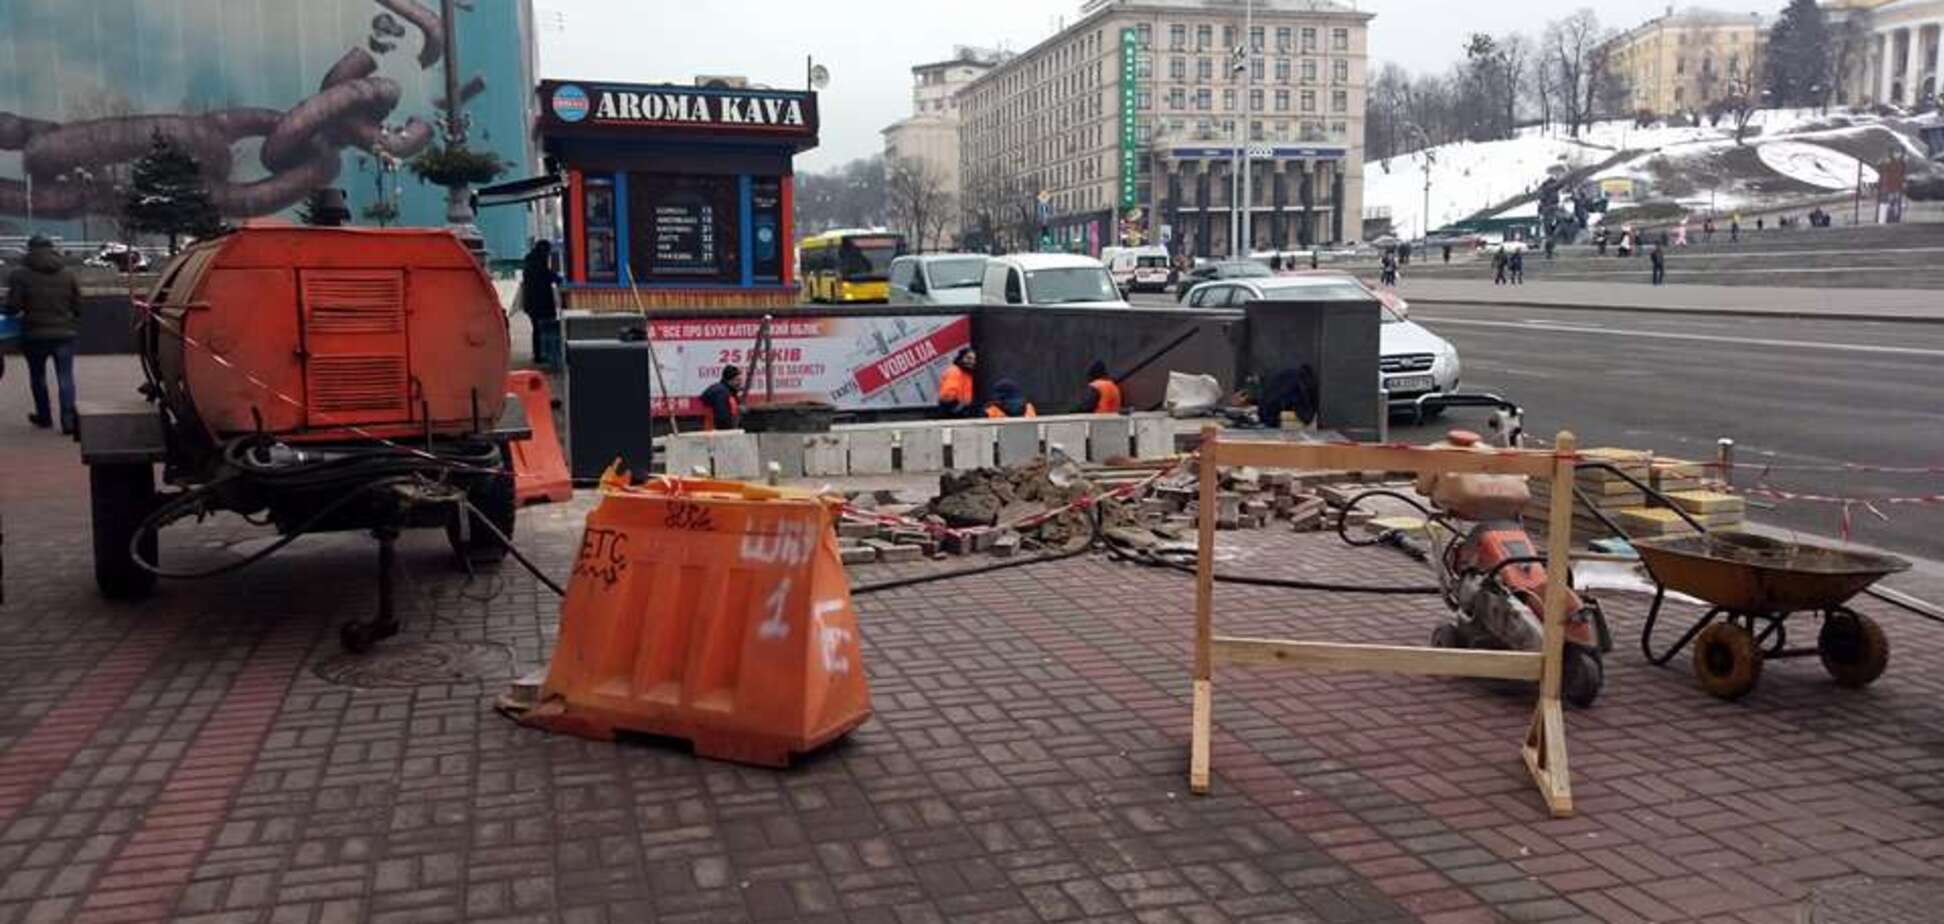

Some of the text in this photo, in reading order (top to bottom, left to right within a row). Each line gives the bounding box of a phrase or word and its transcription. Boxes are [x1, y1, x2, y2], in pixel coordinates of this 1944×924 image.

[596, 91, 804, 126] AROMA KAVA
[719, 349, 741, 363] 25
